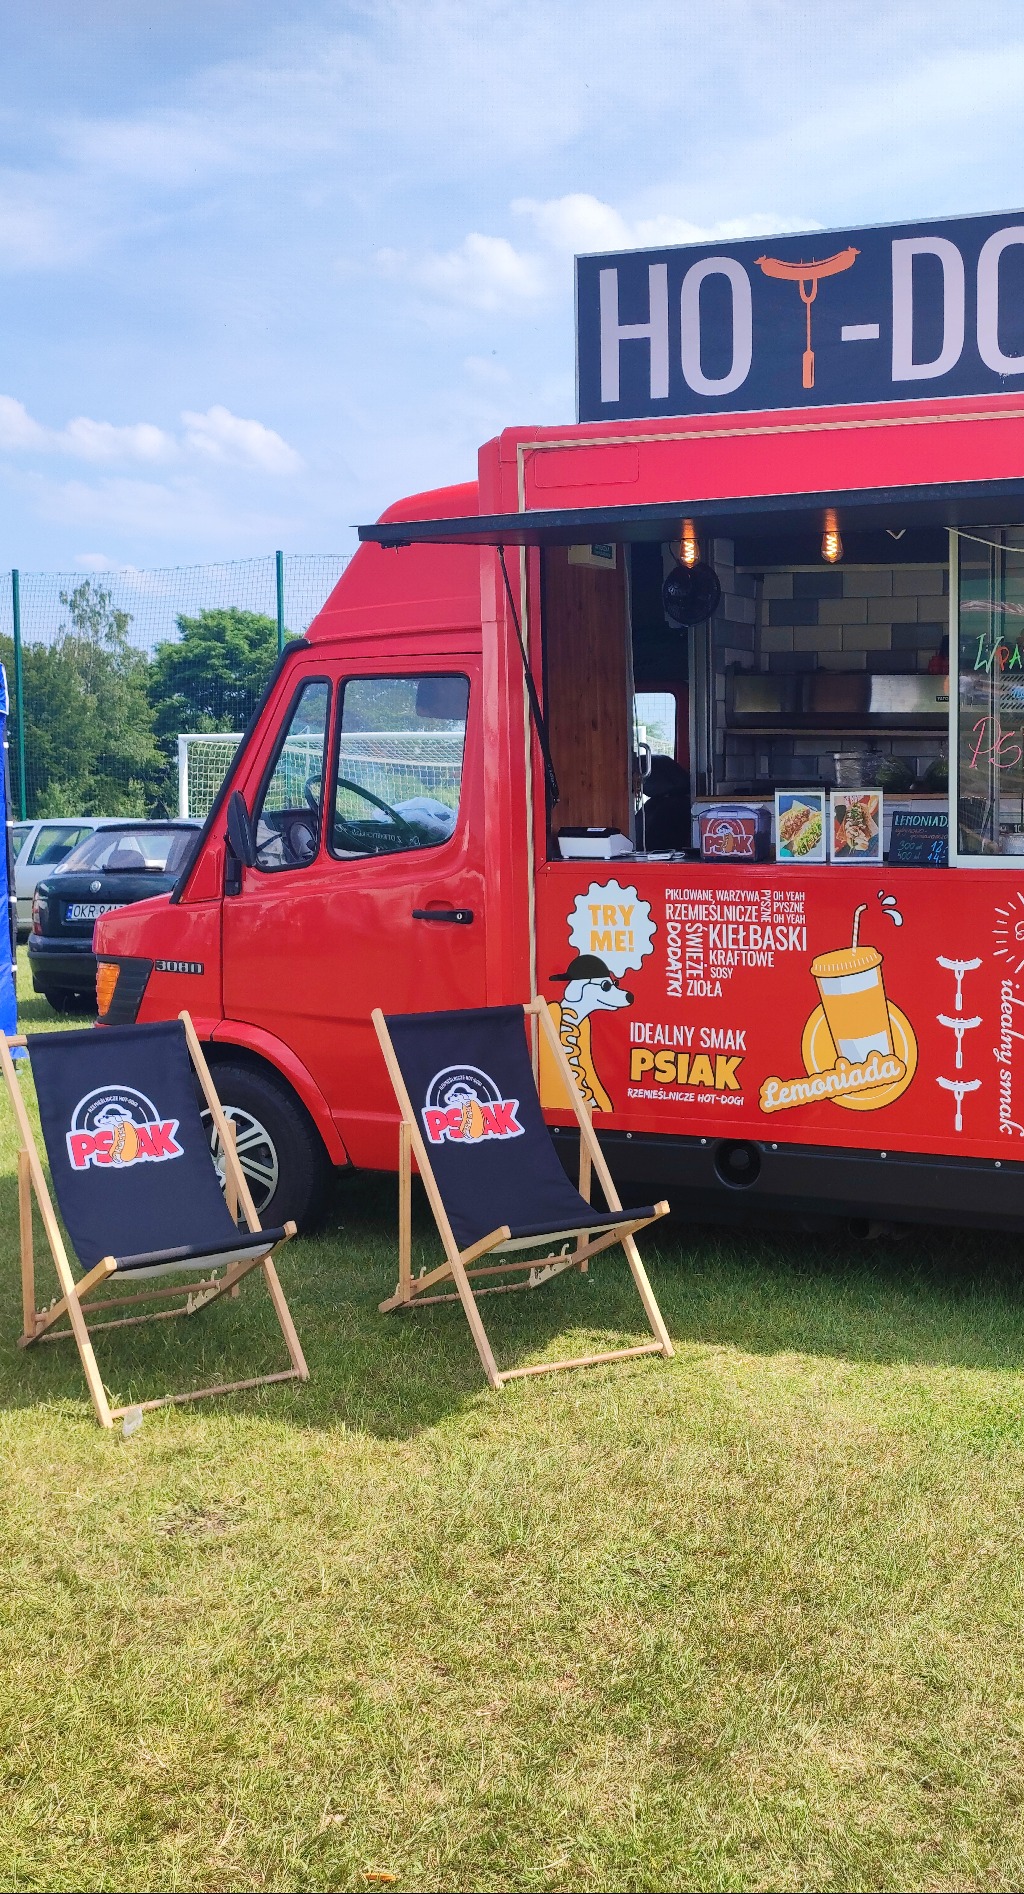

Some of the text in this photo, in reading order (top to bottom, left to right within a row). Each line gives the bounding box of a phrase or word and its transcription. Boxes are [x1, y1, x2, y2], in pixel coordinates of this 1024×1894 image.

[894, 814, 949, 828] LEMONIAD
[665, 888, 760, 903] PIKLOWANE WARZYWA
[760, 889, 772, 923] PYSZNE
[773, 890, 806, 902] OH YEAH
[73, 905, 96, 918] OKR
[587, 904, 636, 927] TRY
[665, 901, 759, 923] RZEMIEŚLNICZE
[773, 902, 805, 913] PYSZNE
[773, 913, 806, 925] OH YEAH
[590, 929, 636, 953] ME!
[708, 924, 808, 952] KIEŁBASKI
[666, 922, 683, 998] DODATKI
[684, 922, 708, 979] ŚWIEŻE
[709, 950, 775, 968] KRAFTOWE
[710, 966, 734, 980] SOSY
[686, 978, 723, 998] ZIOŁA
[629, 1021, 747, 1051] IDEALNY SMAK
[629, 1047, 746, 1091] PSIAK
[764, 1058, 901, 1108] Lemoniada
[627, 1086, 745, 1106] RZEMIEŚLNICZE HOT-DOGI
